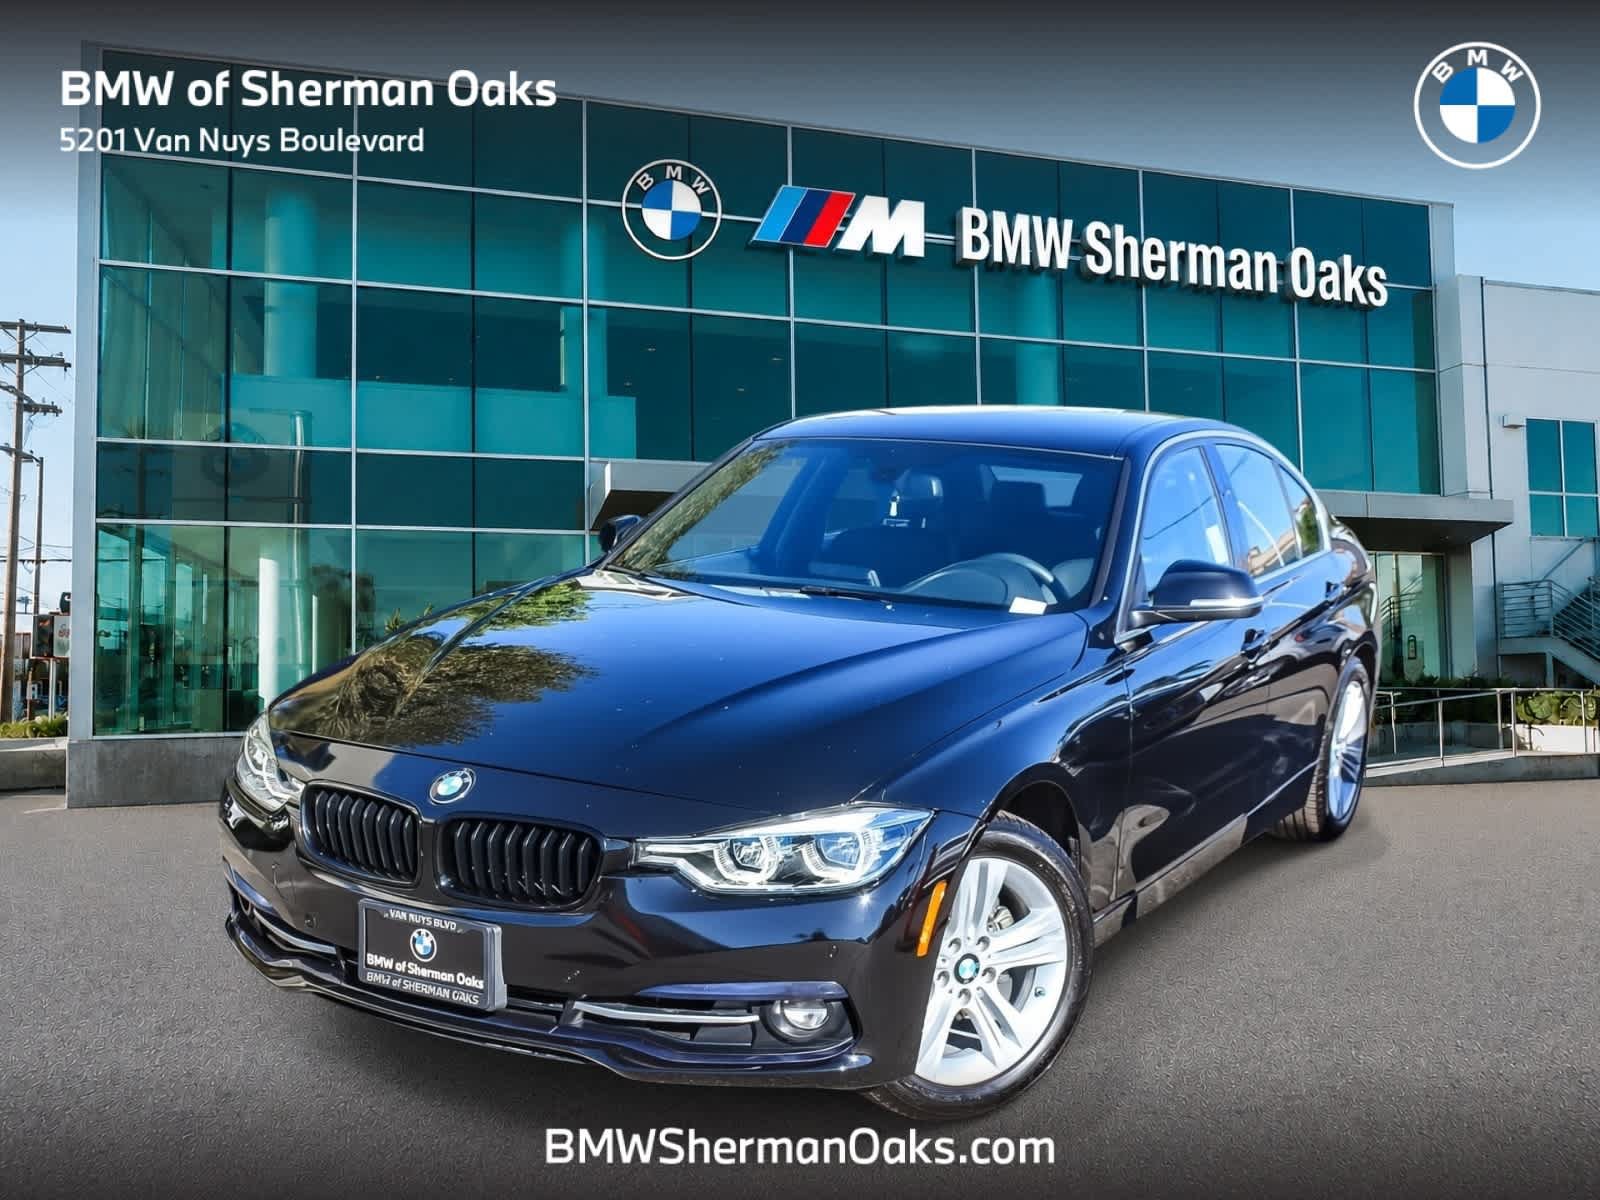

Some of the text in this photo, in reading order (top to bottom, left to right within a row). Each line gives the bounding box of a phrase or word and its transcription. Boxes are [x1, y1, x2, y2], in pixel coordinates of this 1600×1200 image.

[636, 164, 710, 195] BMW
[961, 206, 1388, 308] BMW Sherman Oaks
[389, 909, 407, 921] VAN
[433, 918, 457, 930] BLVD
[366, 953, 485, 990] BMW of Sherman Oaks
[366, 971, 391, 985] BMW
[391, 978, 402, 988] of
[402, 979, 451, 999] SHERMAN
